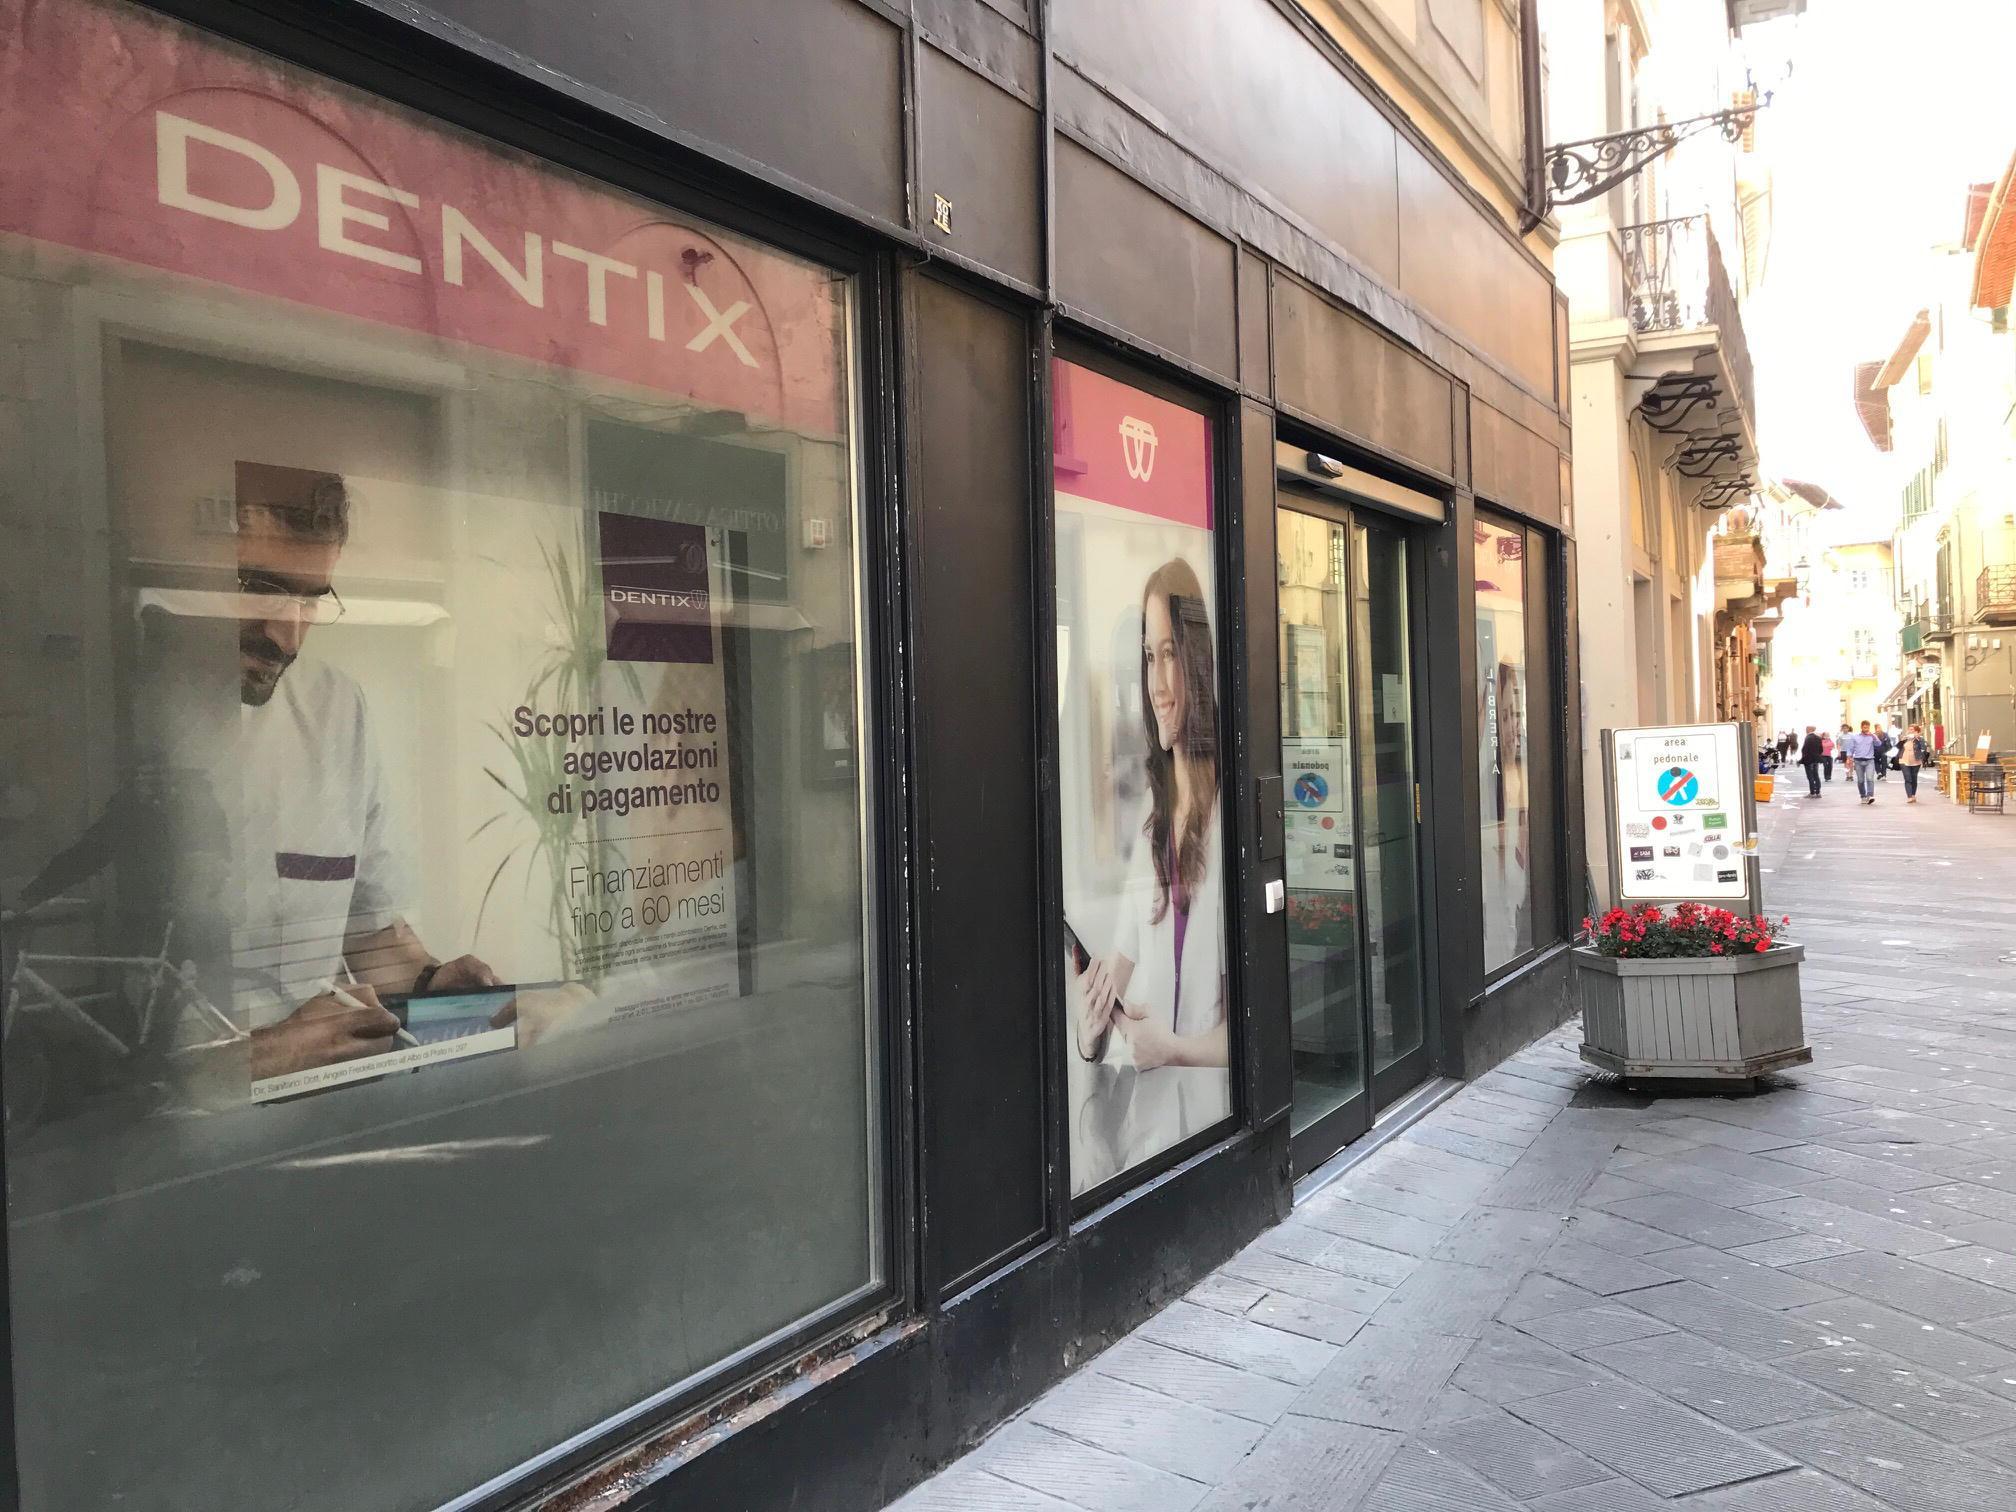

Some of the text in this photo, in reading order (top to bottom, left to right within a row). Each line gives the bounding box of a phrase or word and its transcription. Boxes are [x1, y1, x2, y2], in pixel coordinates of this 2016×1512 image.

[155, 110, 761, 370] DENTIX
[611, 589, 691, 608] DENTIX
[514, 705, 717, 743] Scopri le nostre
[1664, 738, 1686, 747] area
[563, 741, 718, 781] agevolazioni
[1653, 753, 1699, 765] pedonale
[547, 778, 720, 818] di pagamento
[570, 850, 724, 898] Finanziamenti
[571, 886, 725, 937] fino a 60 mesi
